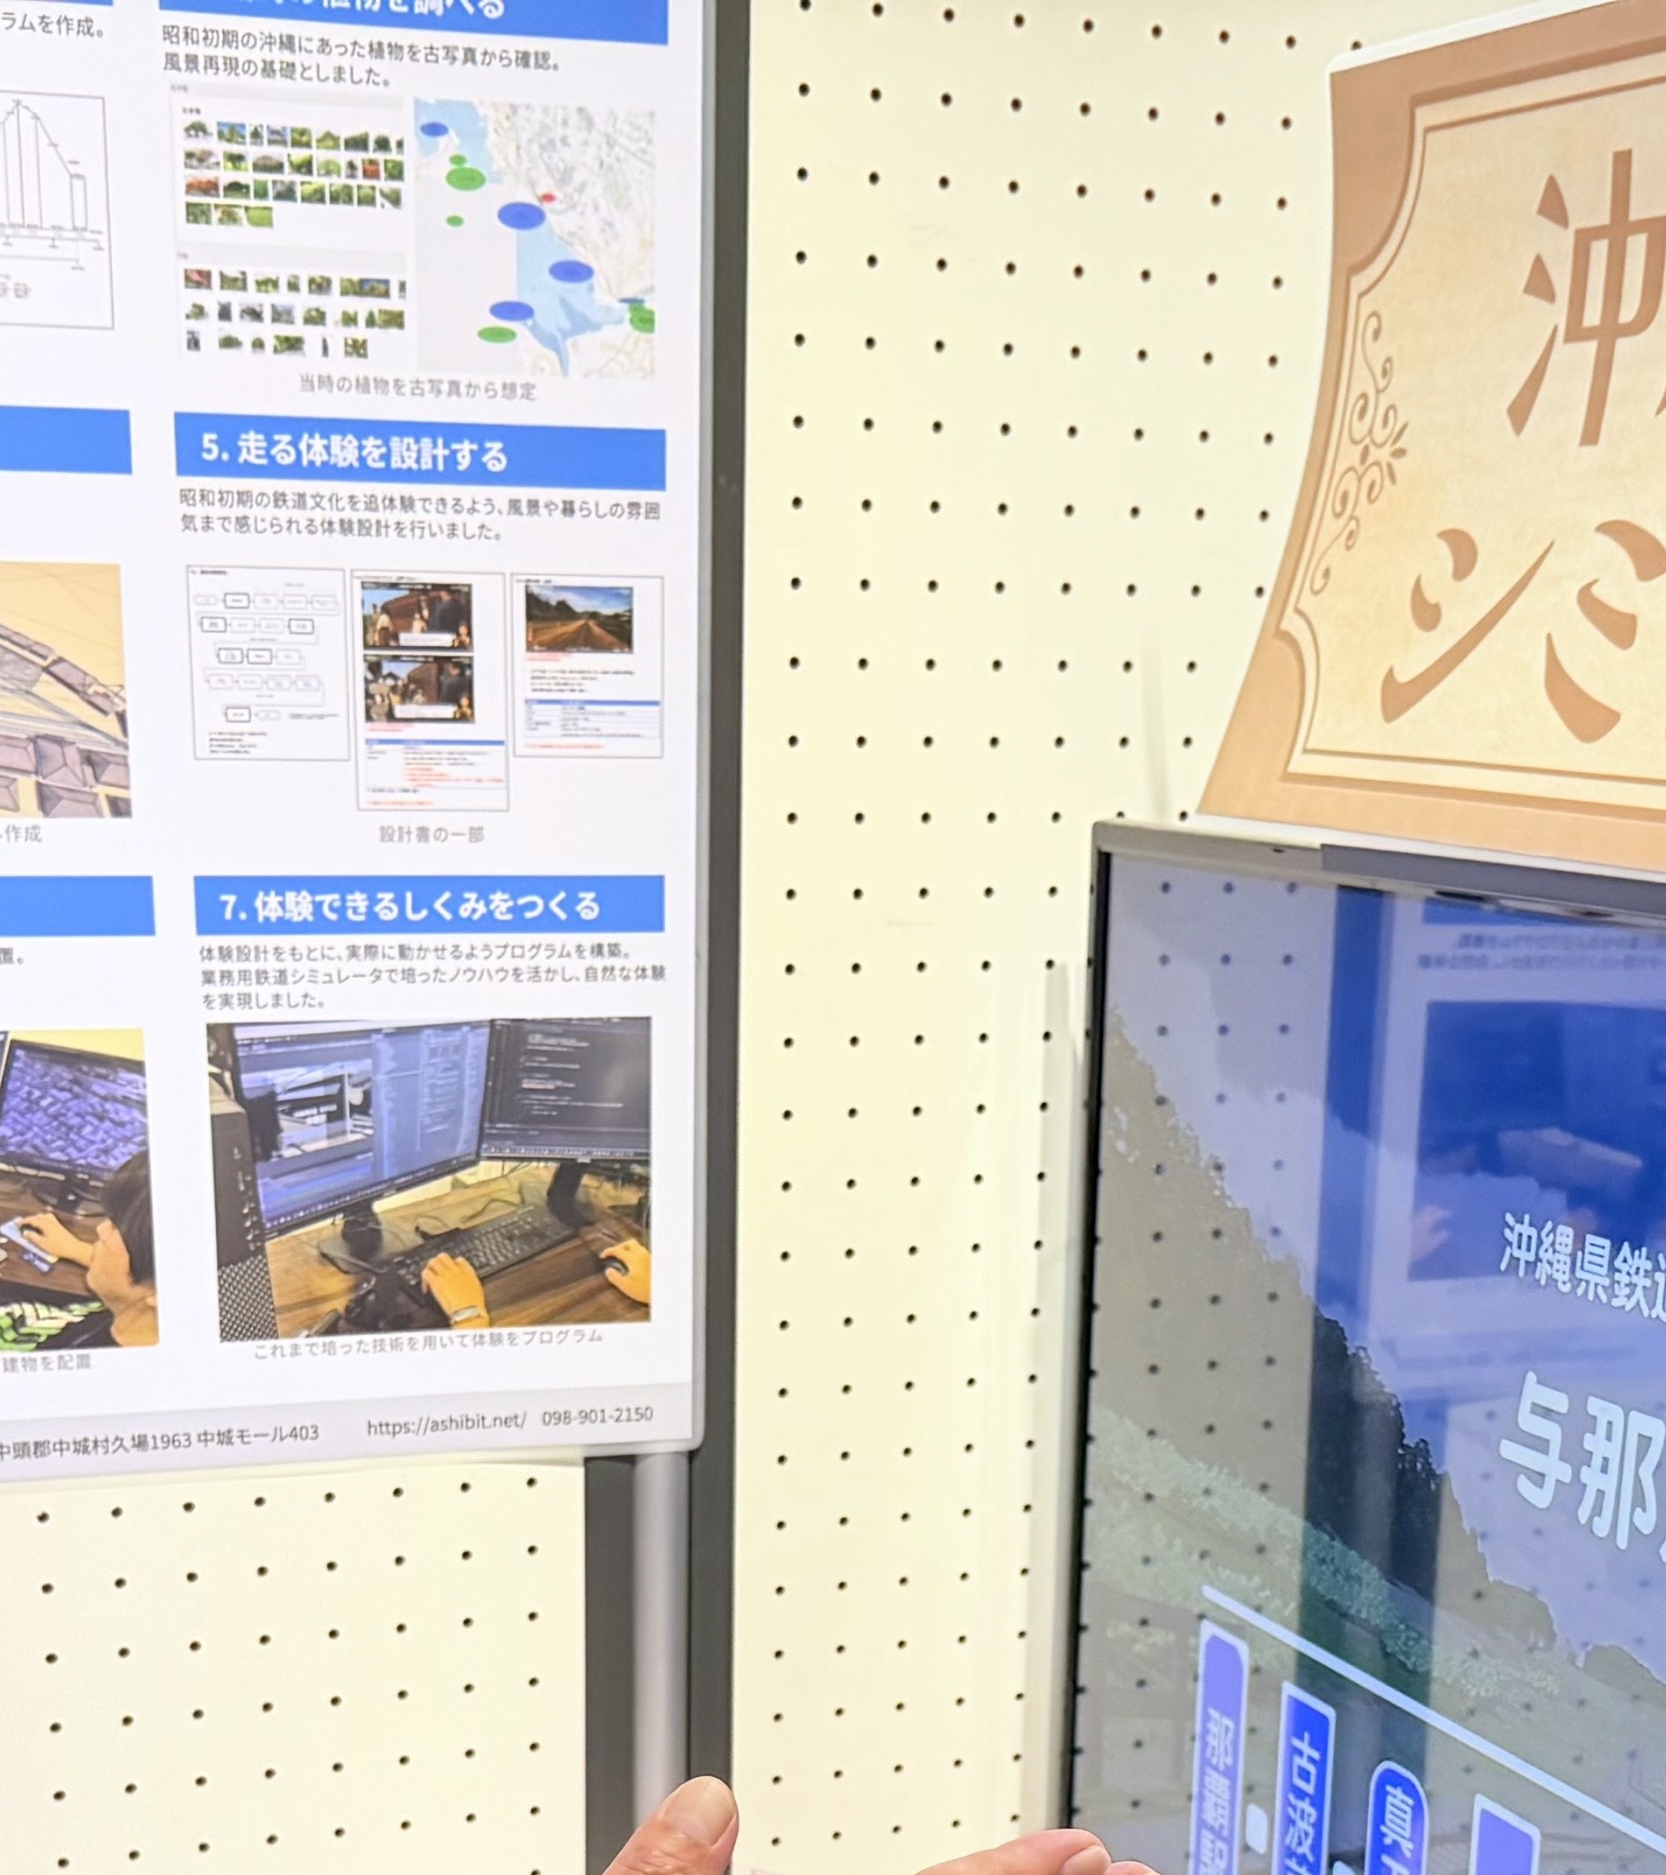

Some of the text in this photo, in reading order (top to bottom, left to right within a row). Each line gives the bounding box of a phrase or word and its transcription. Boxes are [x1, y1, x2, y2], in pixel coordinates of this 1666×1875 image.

[162, 23, 560, 72] 昭和初期の沖縄にあった植物を古写真から確認。
[163, 52, 391, 88] 風景再現の基礎としました。
[299, 373, 537, 402] 当時の植物を古写真から想定
[201, 431, 509, 472] 5. 走る体験を設計する
[379, 825, 486, 845] 設計書の一部
[220, 891, 601, 923] 7. 体験できるしくみをつくる
[202, 992, 326, 1010] を実現しました。
[197, 1424, 319, 1447] 中城モール403
[367, 1411, 528, 1437] https://ashibit.net/
[542, 1406, 654, 1426] 098-901-2150
